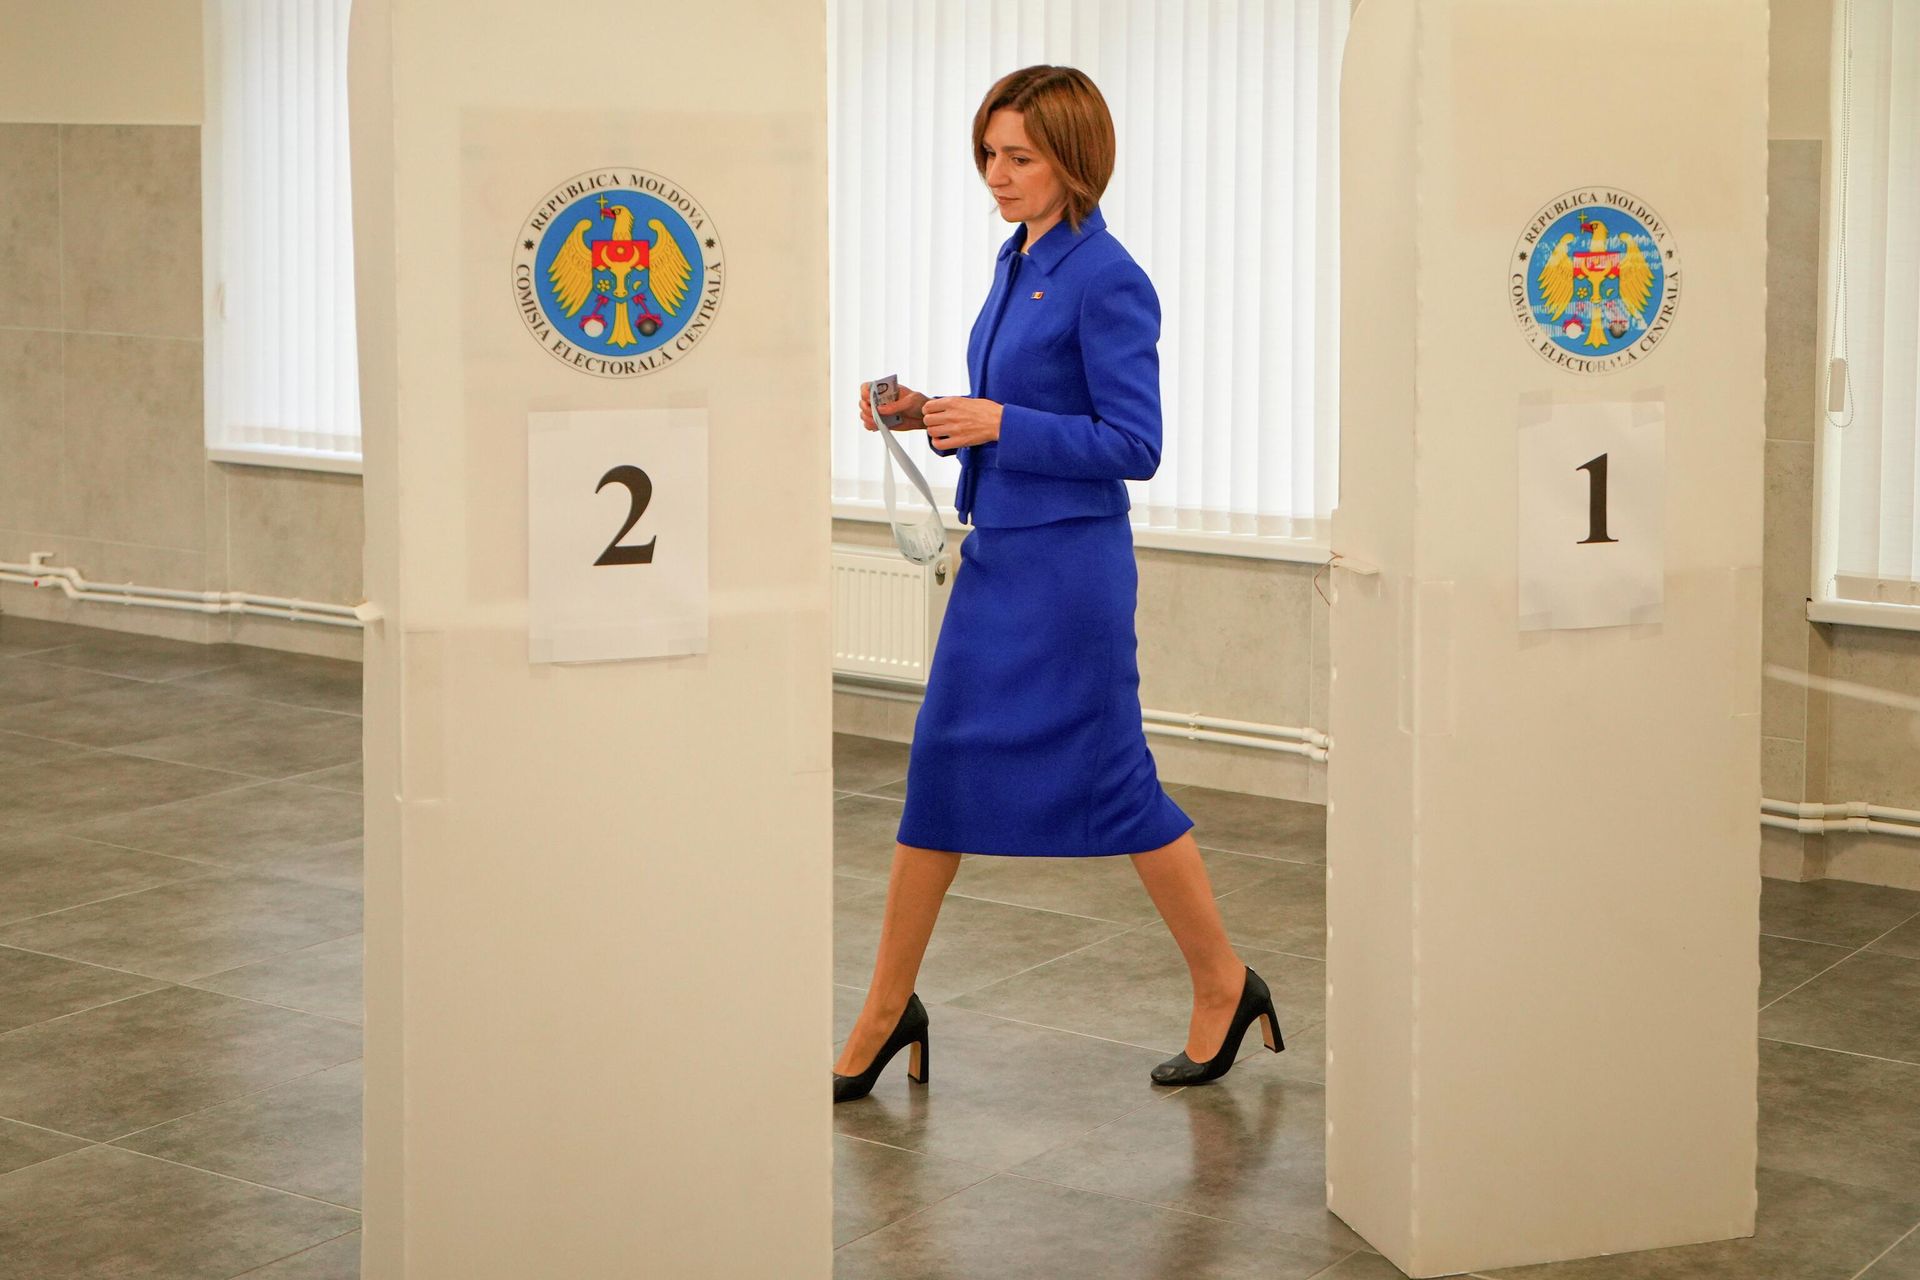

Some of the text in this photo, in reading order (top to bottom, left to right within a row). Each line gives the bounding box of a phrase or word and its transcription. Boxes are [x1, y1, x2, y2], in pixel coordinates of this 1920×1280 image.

[531, 173, 704, 232] REPUBLICA MOLDOVA
[1524, 192, 1666, 244] REPUBLICA MOLDOVA
[515, 261, 722, 375] COMISIA ELECTORALĂ CENTRALĂ
[1639, 271, 1679, 352] CENTRALĂ
[592, 464, 657, 567] 2
[1575, 452, 1619, 545] 1
